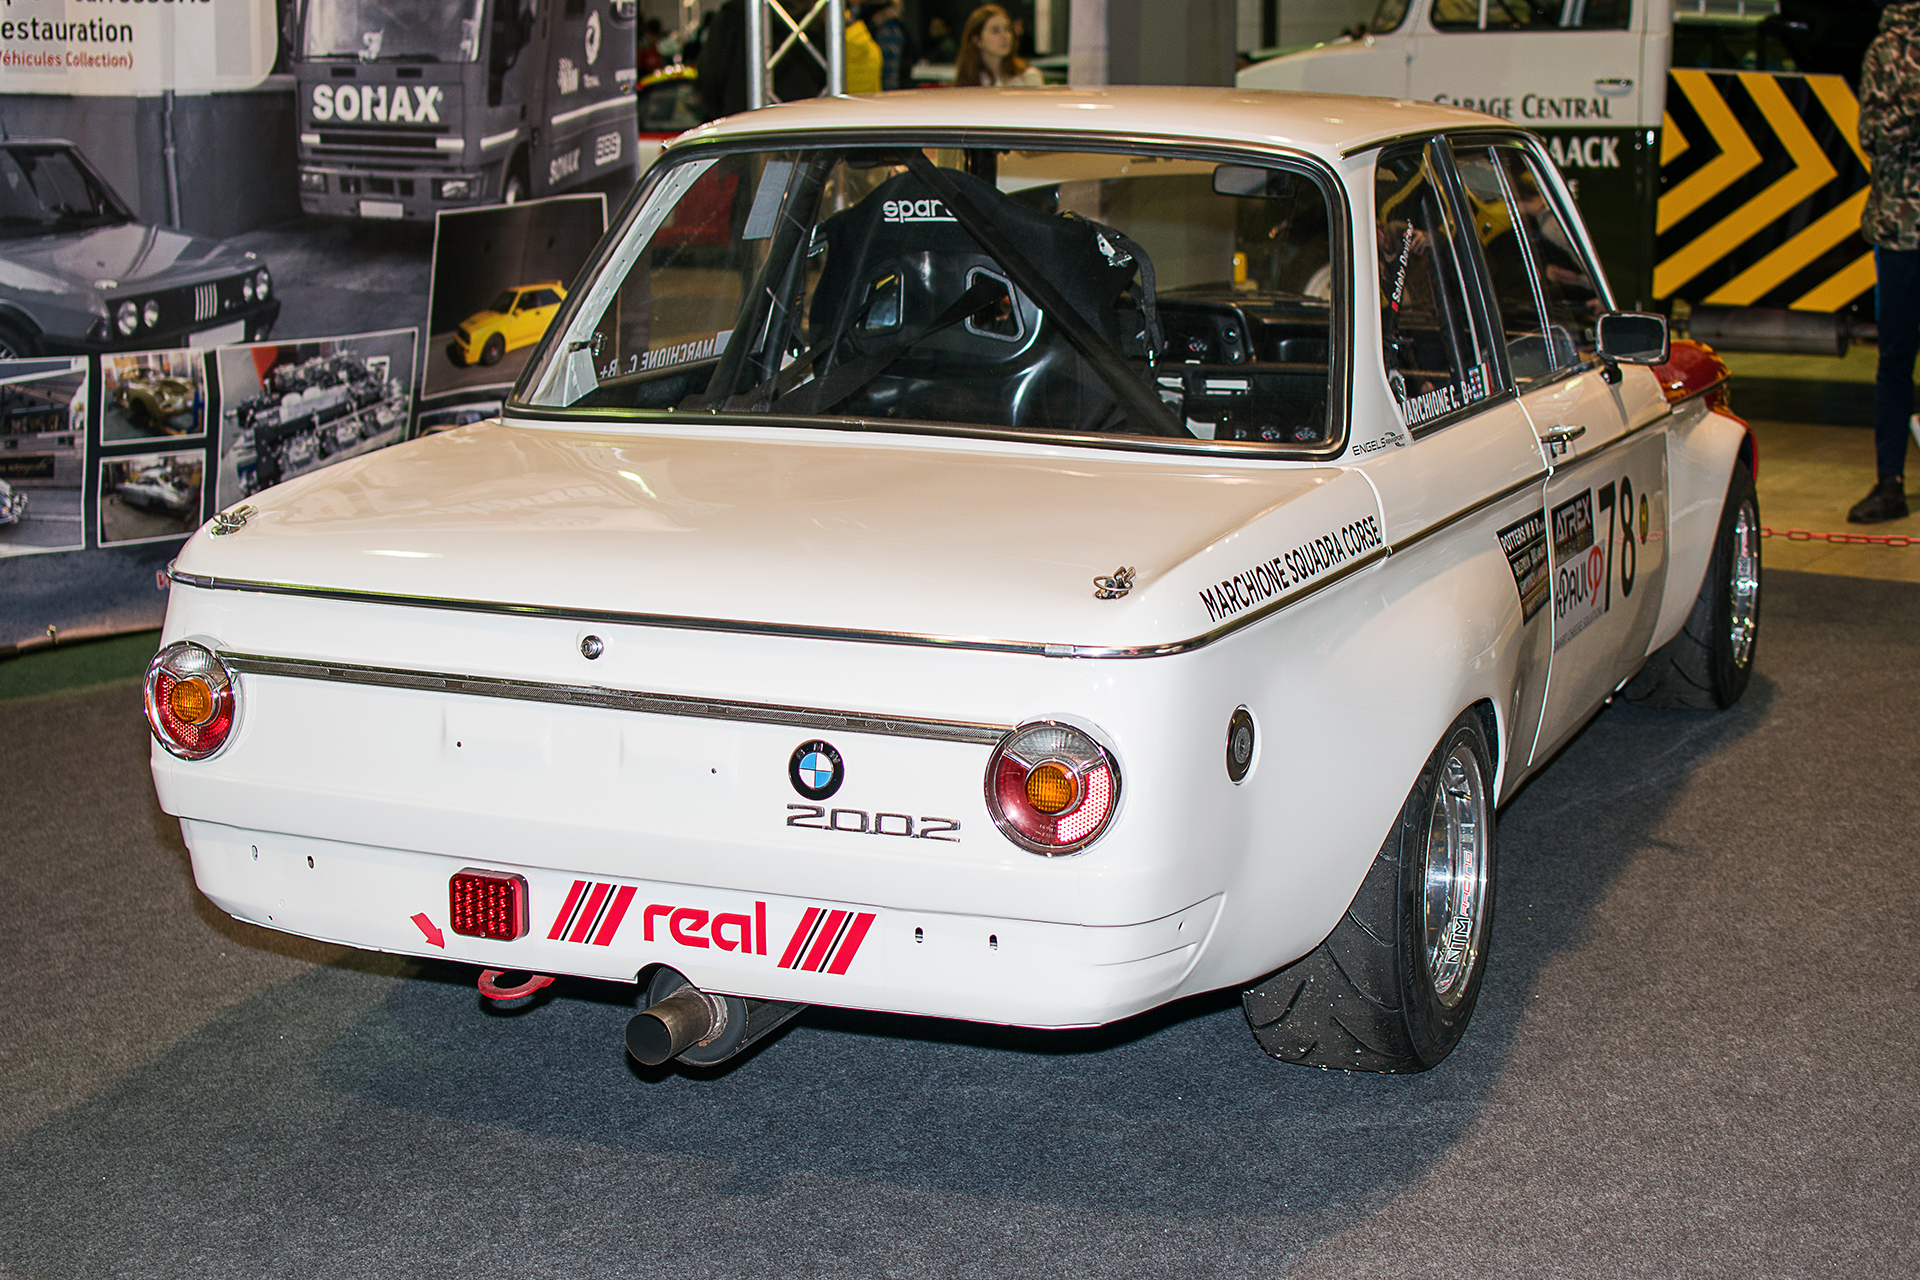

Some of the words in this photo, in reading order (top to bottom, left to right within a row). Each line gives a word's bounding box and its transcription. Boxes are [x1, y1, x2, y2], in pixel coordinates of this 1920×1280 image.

[0, 17, 134, 42] estauration
[0, 49, 62, 67] éhicules
[65, 51, 134, 70] Collection)
[312, 84, 440, 122] SONAX
[1521, 93, 1612, 119] CENTRAL
[1546, 135, 1620, 167] AACK
[882, 199, 954, 224] spar
[1391, 267, 1406, 304] Safety
[1352, 437, 1387, 456] ENGELS
[1500, 525, 1527, 554] POTTERS
[1597, 475, 1636, 613] 78
[1199, 557, 1290, 622] MARCHIONE
[1284, 532, 1347, 583] SQUADRA
[1341, 515, 1382, 556] CORSE
[786, 803, 961, 843] 2002
[1460, 850, 1473, 917] RACING
[643, 901, 767, 956] real
